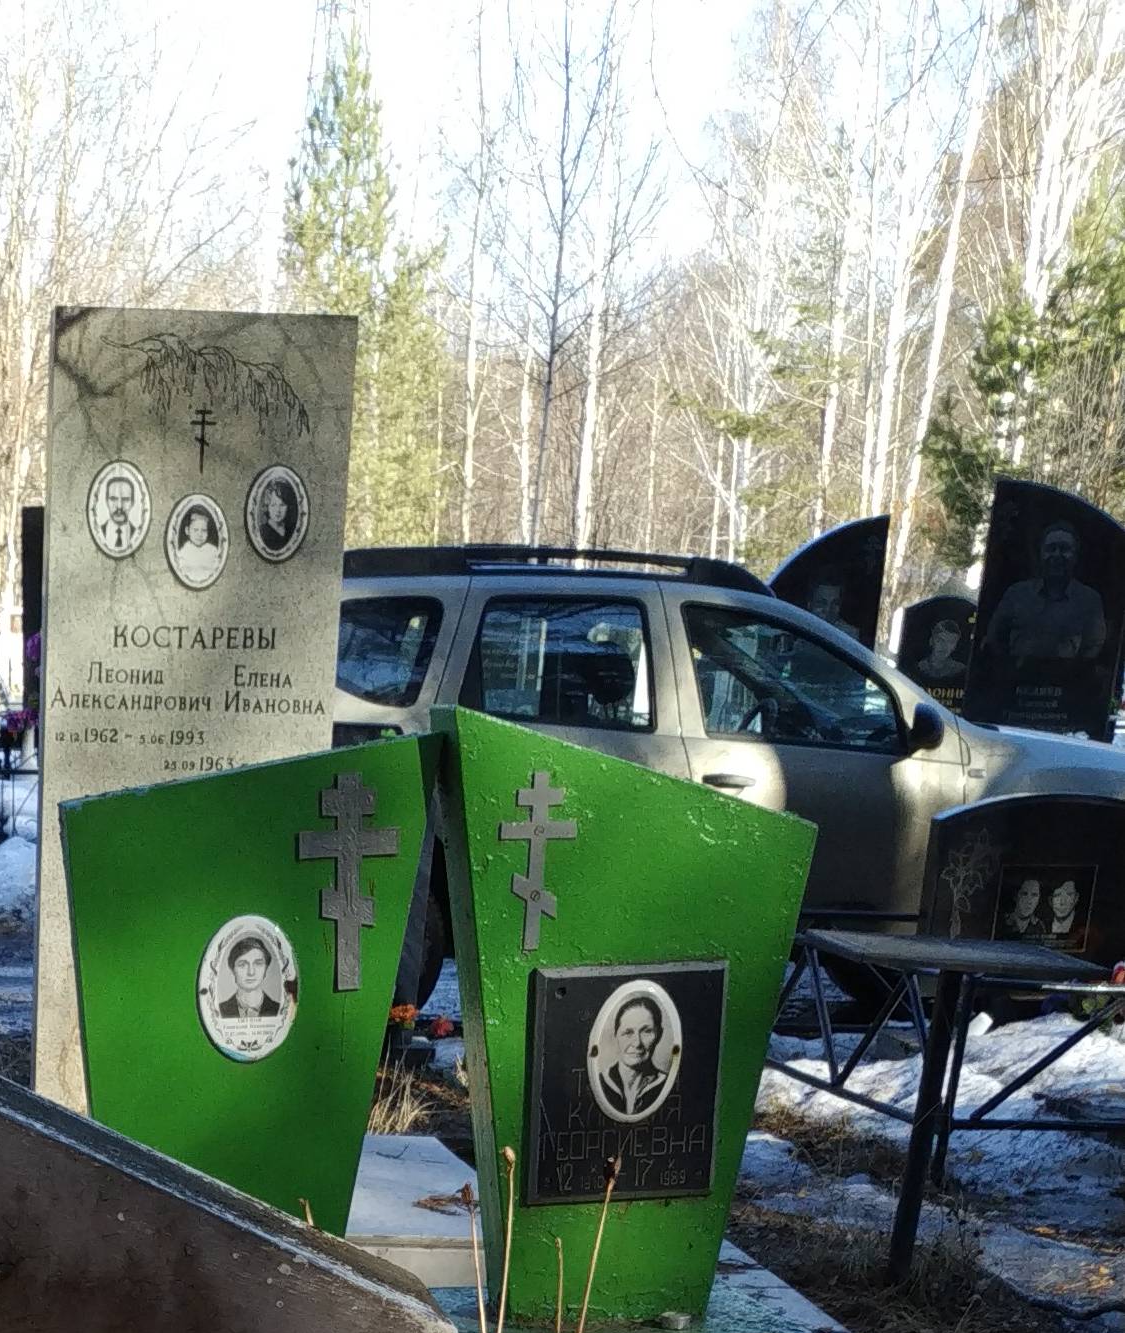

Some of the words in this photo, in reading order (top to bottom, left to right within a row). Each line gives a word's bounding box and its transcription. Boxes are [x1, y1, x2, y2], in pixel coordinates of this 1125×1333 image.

[112, 625, 277, 650] КОСТАРЕВЫ
[542, 1124, 707, 1161] ГЕОРГИЕВНА
[634, 1158, 655, 1188] 17
